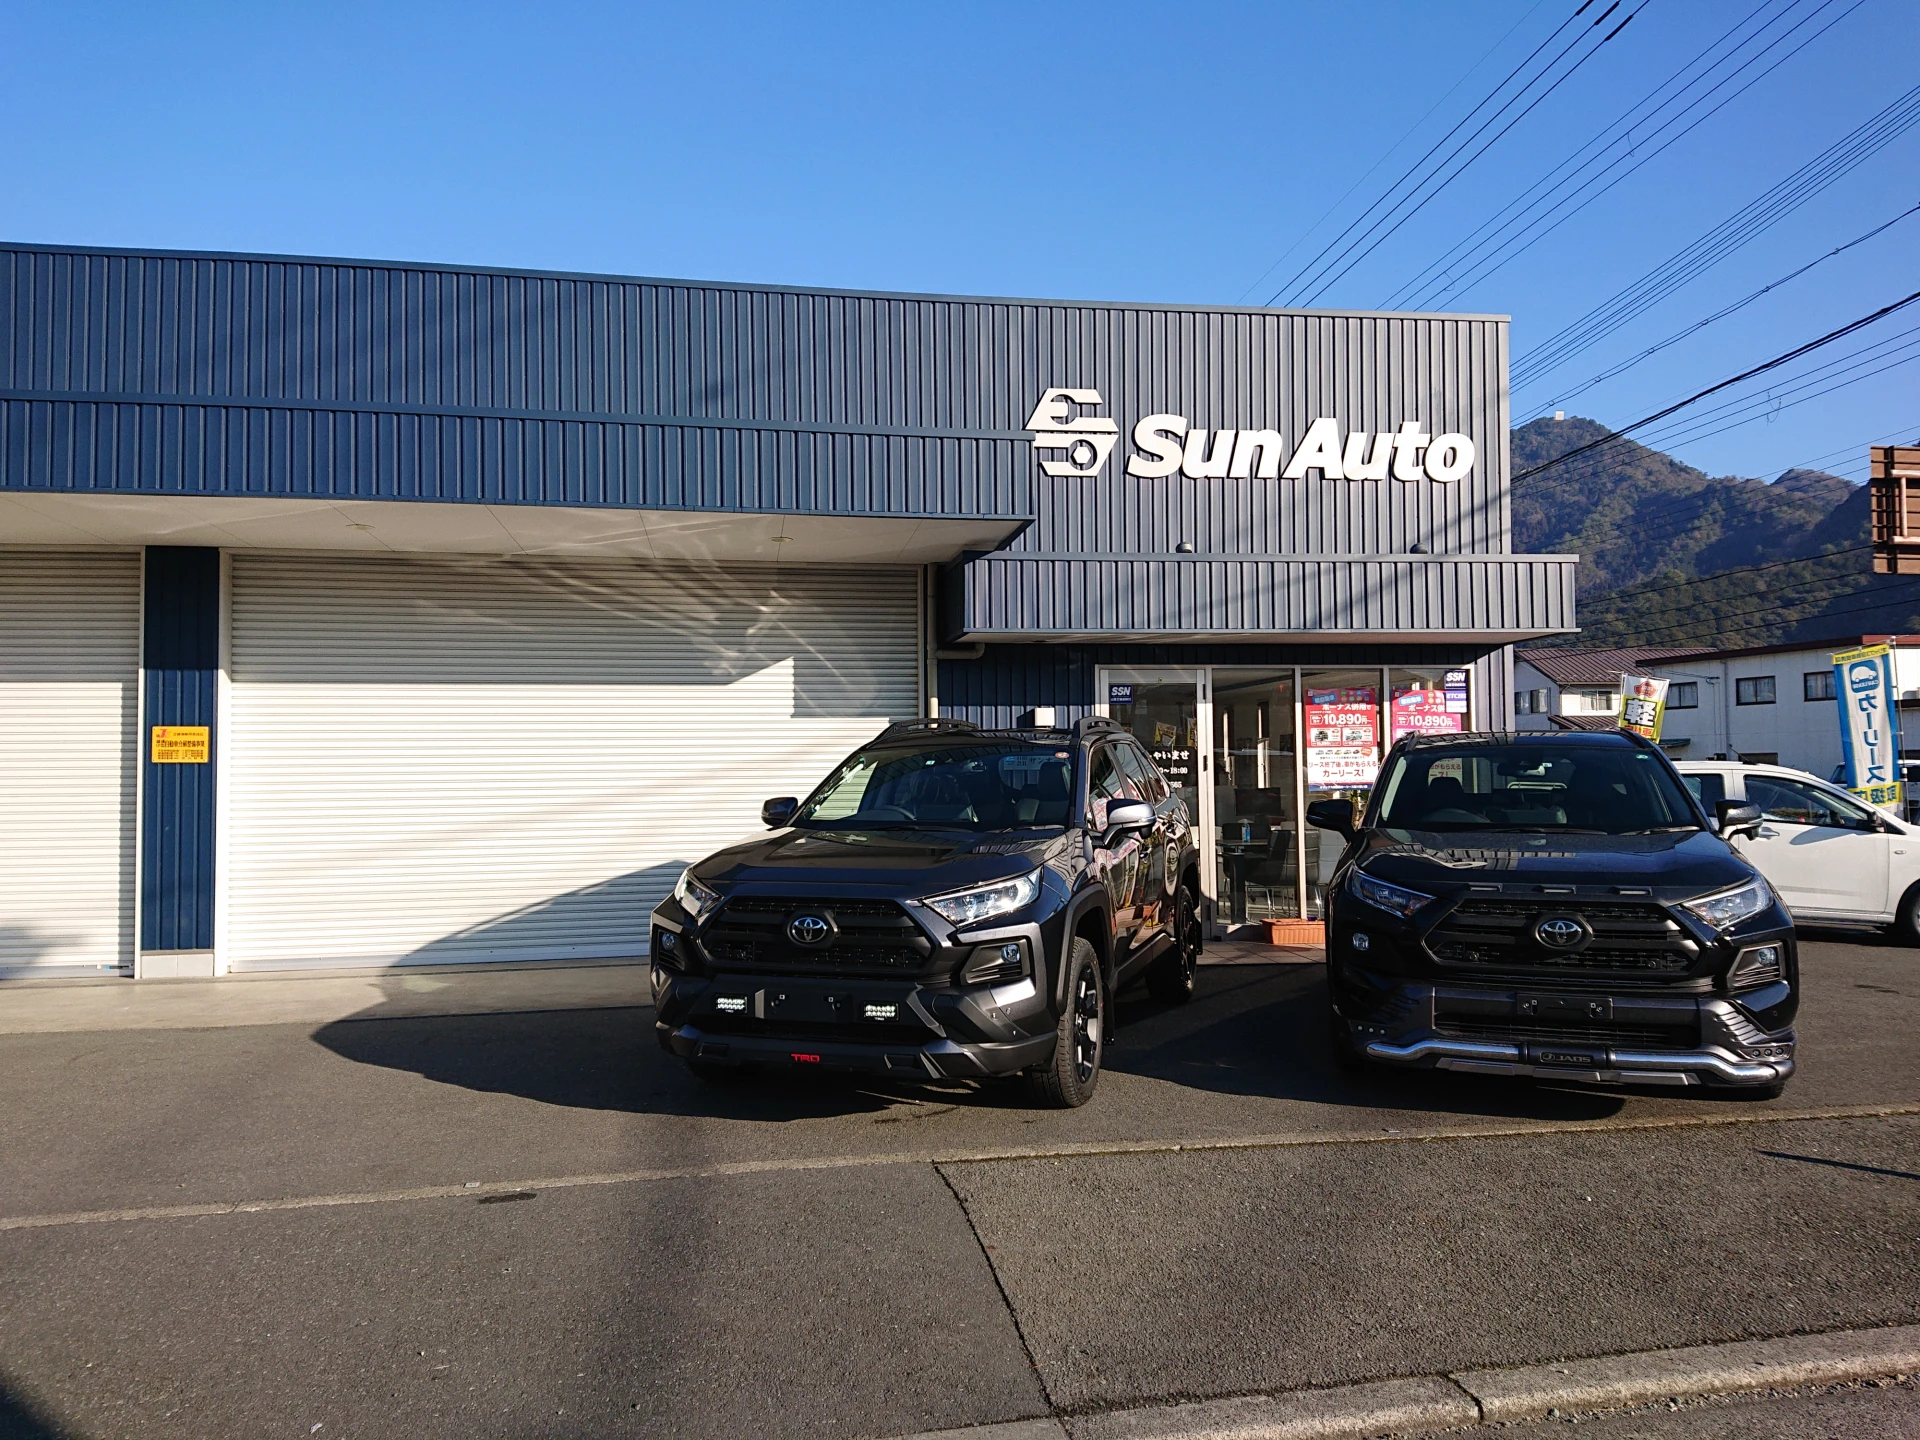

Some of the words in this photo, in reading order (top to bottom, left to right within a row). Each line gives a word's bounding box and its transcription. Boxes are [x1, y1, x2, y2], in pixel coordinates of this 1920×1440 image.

[1446, 672, 1466, 682] SSN
[1111, 686, 1131, 696] SSN
[1624, 698, 1657, 727] 軽
[1149, 750, 1190, 760] ゃいませ
